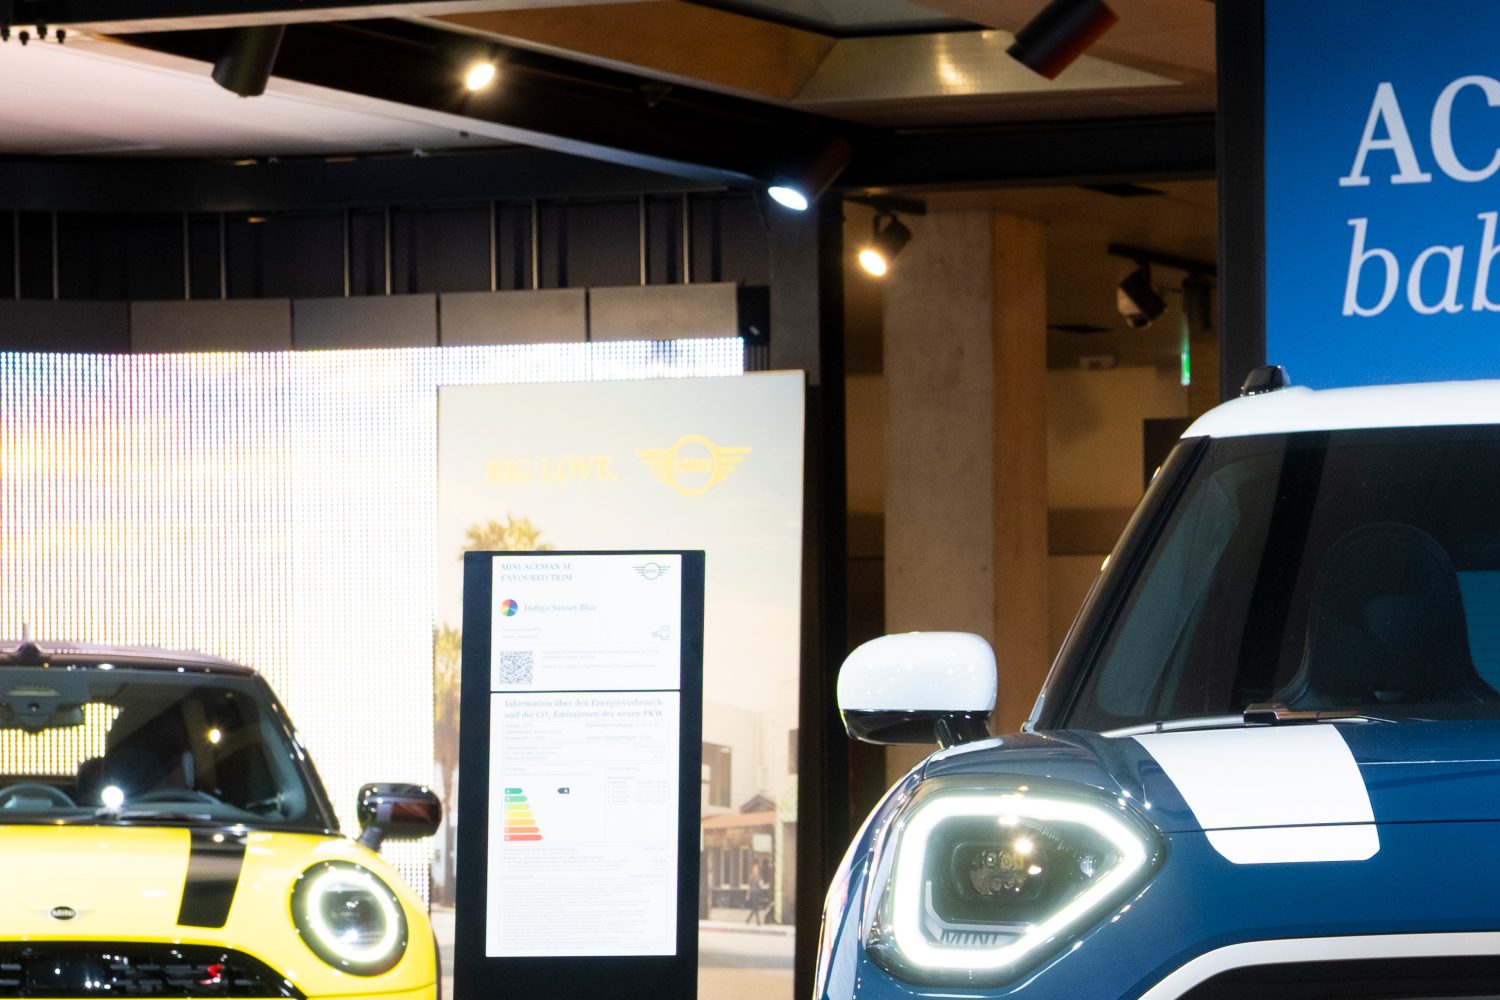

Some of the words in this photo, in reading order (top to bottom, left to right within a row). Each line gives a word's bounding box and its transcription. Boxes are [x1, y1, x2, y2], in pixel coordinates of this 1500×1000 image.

[485, 458, 533, 486] BIG
[500, 563, 522, 571] MINI
[524, 563, 561, 571] ACEMAN
[562, 562, 573, 570] SE
[500, 574, 548, 582] FAVOURED
[550, 573, 573, 582] TRIM
[552, 604, 578, 612] Sunset
[579, 603, 597, 612] Blue
[504, 699, 553, 708] Information
[574, 699, 590, 707] den
[591, 698, 663, 708] Energieverbrauch
[553, 711, 600, 719] Emissionen
[642, 709, 664, 718] PKW
[940, 929, 998, 945] MINI
